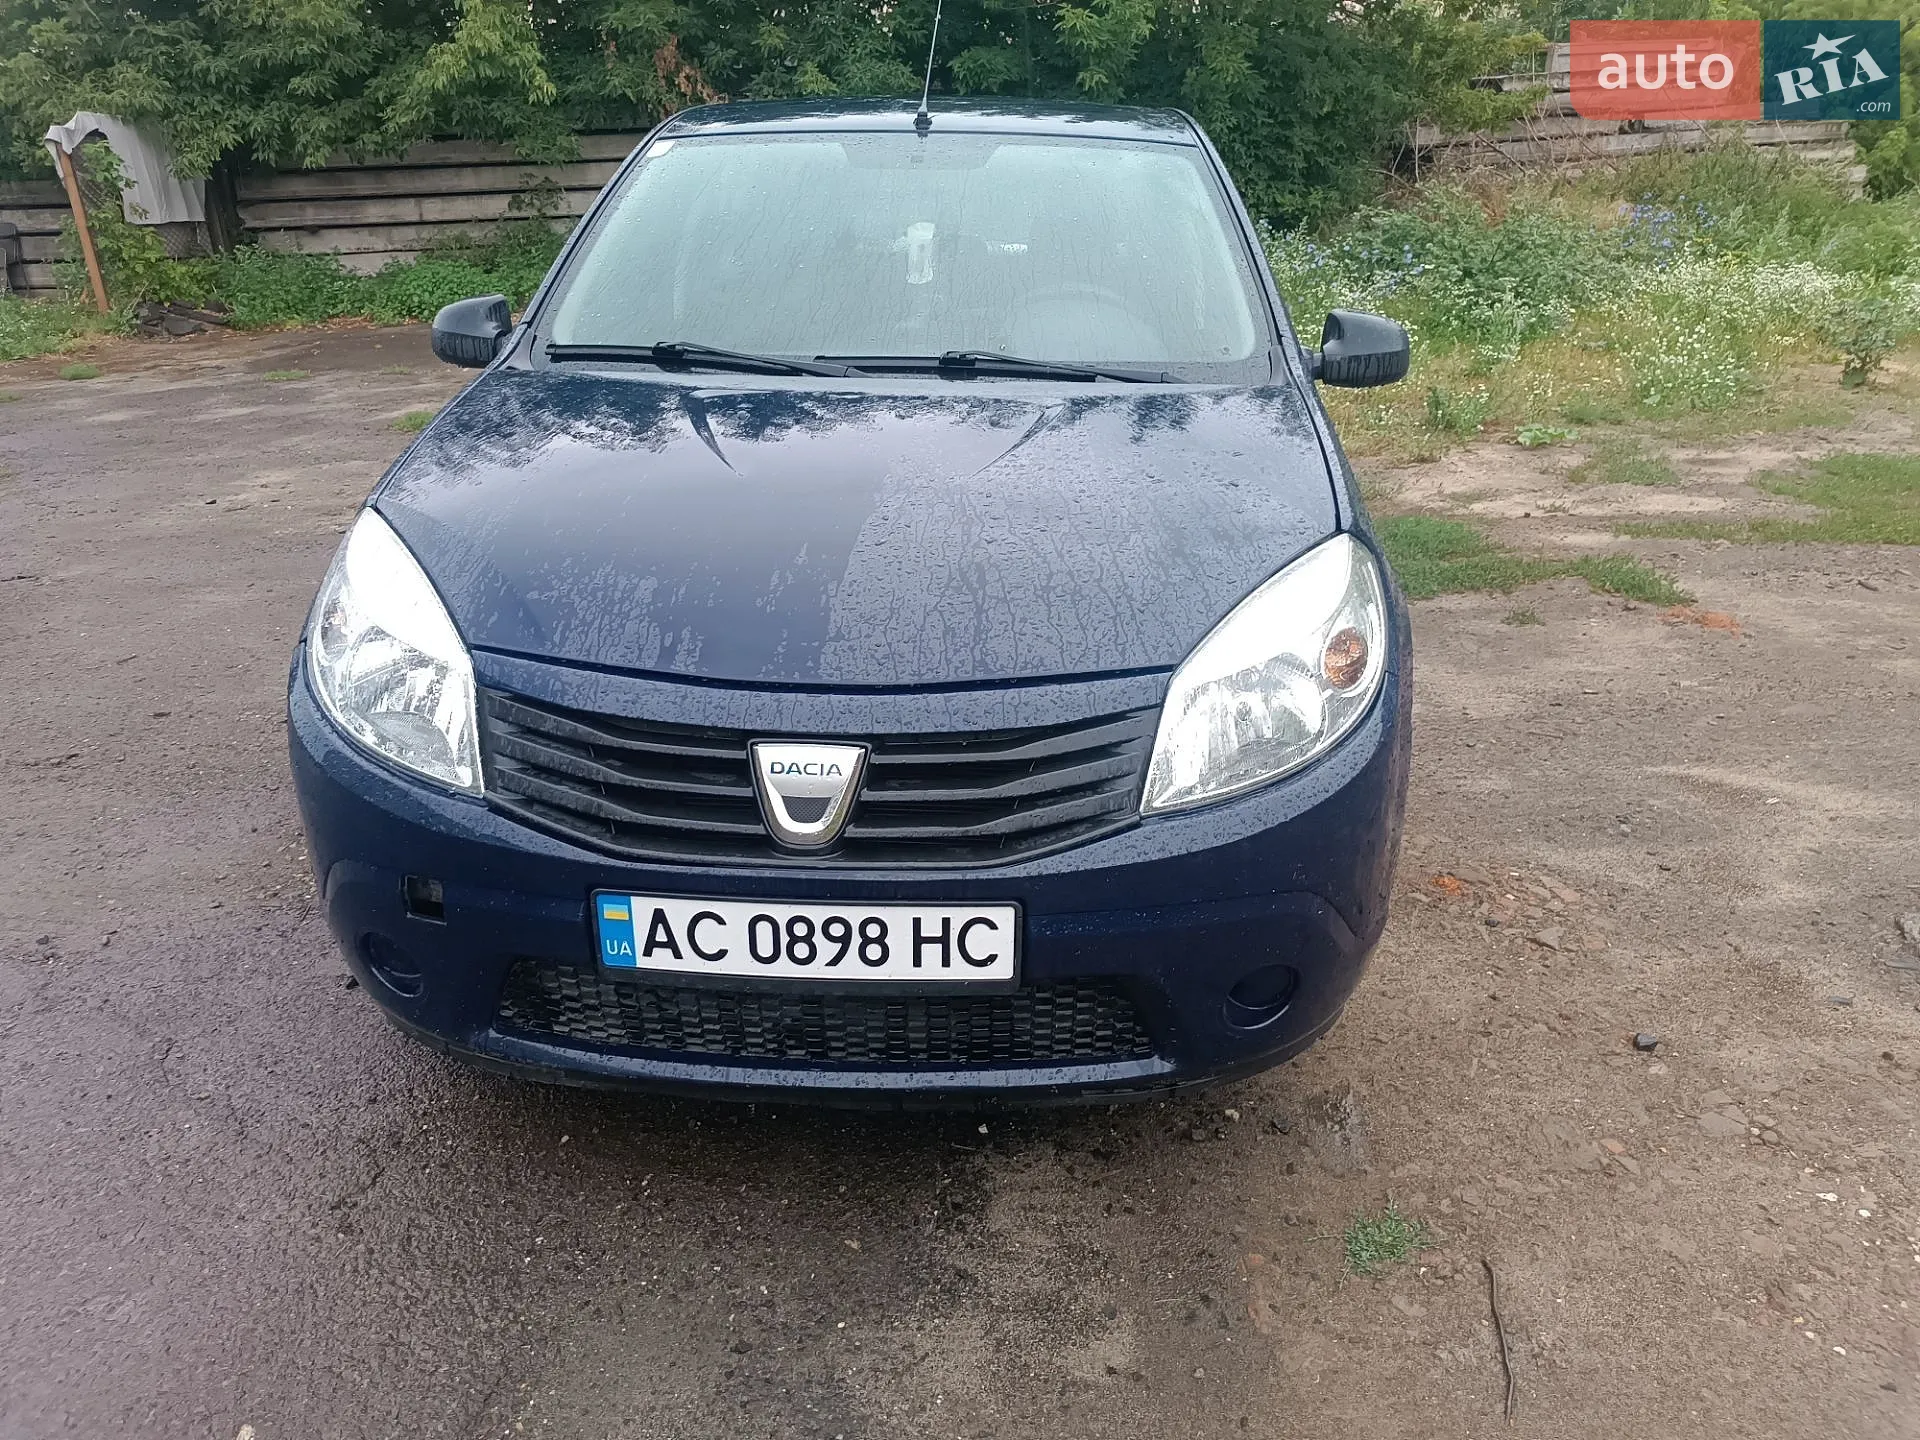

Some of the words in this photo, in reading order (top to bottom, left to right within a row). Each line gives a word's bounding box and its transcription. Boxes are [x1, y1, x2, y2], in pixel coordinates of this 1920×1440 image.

[770, 761, 842, 776] DACIA
[642, 908, 729, 962] AC
[747, 913, 890, 967] 0898
[912, 916, 999, 967] HC
[606, 939, 632, 957] UA
